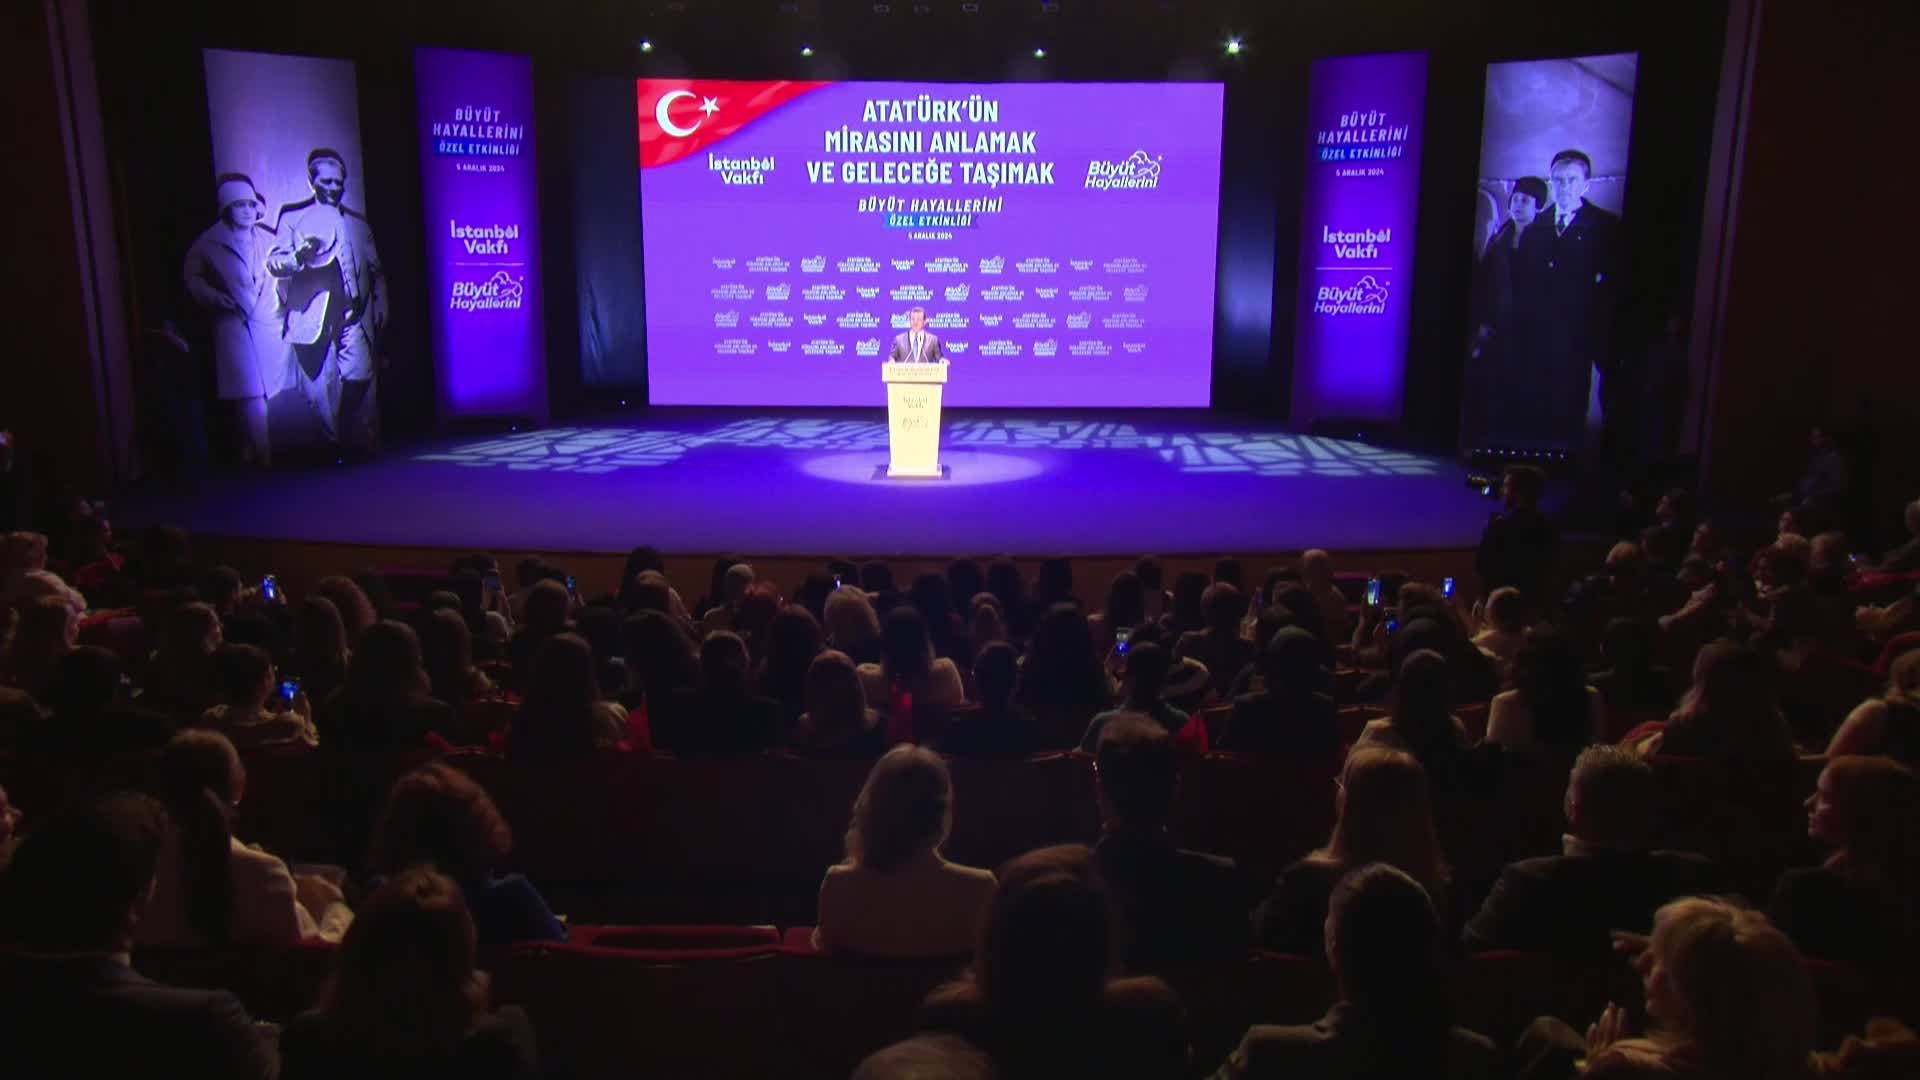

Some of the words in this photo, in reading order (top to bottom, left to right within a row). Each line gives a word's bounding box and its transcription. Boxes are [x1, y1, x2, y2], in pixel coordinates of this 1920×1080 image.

[455, 105, 500, 123] BÜYÜT
[863, 95, 998, 122] ATATÜRK’ÜN
[1340, 109, 1387, 128] BÜYÜT
[433, 123, 523, 140] HAYALLERİNİ
[824, 125, 922, 153] MİRASINI
[930, 131, 1037, 153] ANLAMAK
[1318, 124, 1408, 144] HAYALLERİNİ
[440, 140, 465, 153] ÖZEL
[1321, 147, 1346, 160] ÖZEL
[806, 161, 834, 184] VE
[842, 157, 952, 184] GELECEĞE
[960, 162, 1055, 188] TAŞIMAK
[1088, 160, 1136, 179] Büyüt
[1085, 175, 1158, 190] Hayallerini
[858, 195, 906, 212] BÜYÜT
[910, 195, 1003, 212] HAYALLERİNİ
[889, 213, 915, 226] ÖZEL
[453, 281, 499, 300] Büyüt
[1317, 286, 1364, 304] Büyüt
[450, 297, 522, 312] Hayallerini
[1314, 301, 1385, 315] Hayallerini
